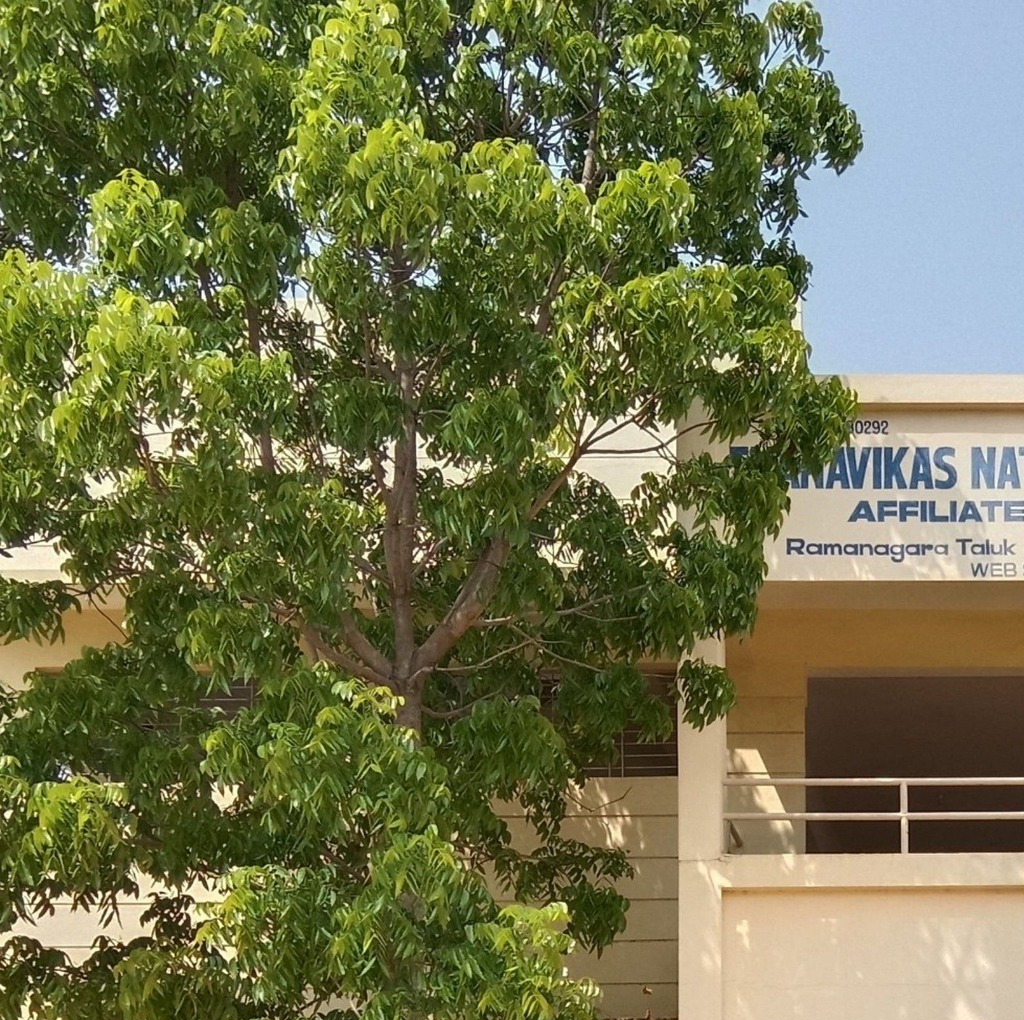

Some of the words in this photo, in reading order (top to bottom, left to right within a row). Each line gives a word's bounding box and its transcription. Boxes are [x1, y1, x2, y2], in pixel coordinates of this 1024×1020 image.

[786, 538, 948, 562] Ramanagara
[955, 538, 1016, 556] Taluk
[970, 562, 1017, 578] WEB
